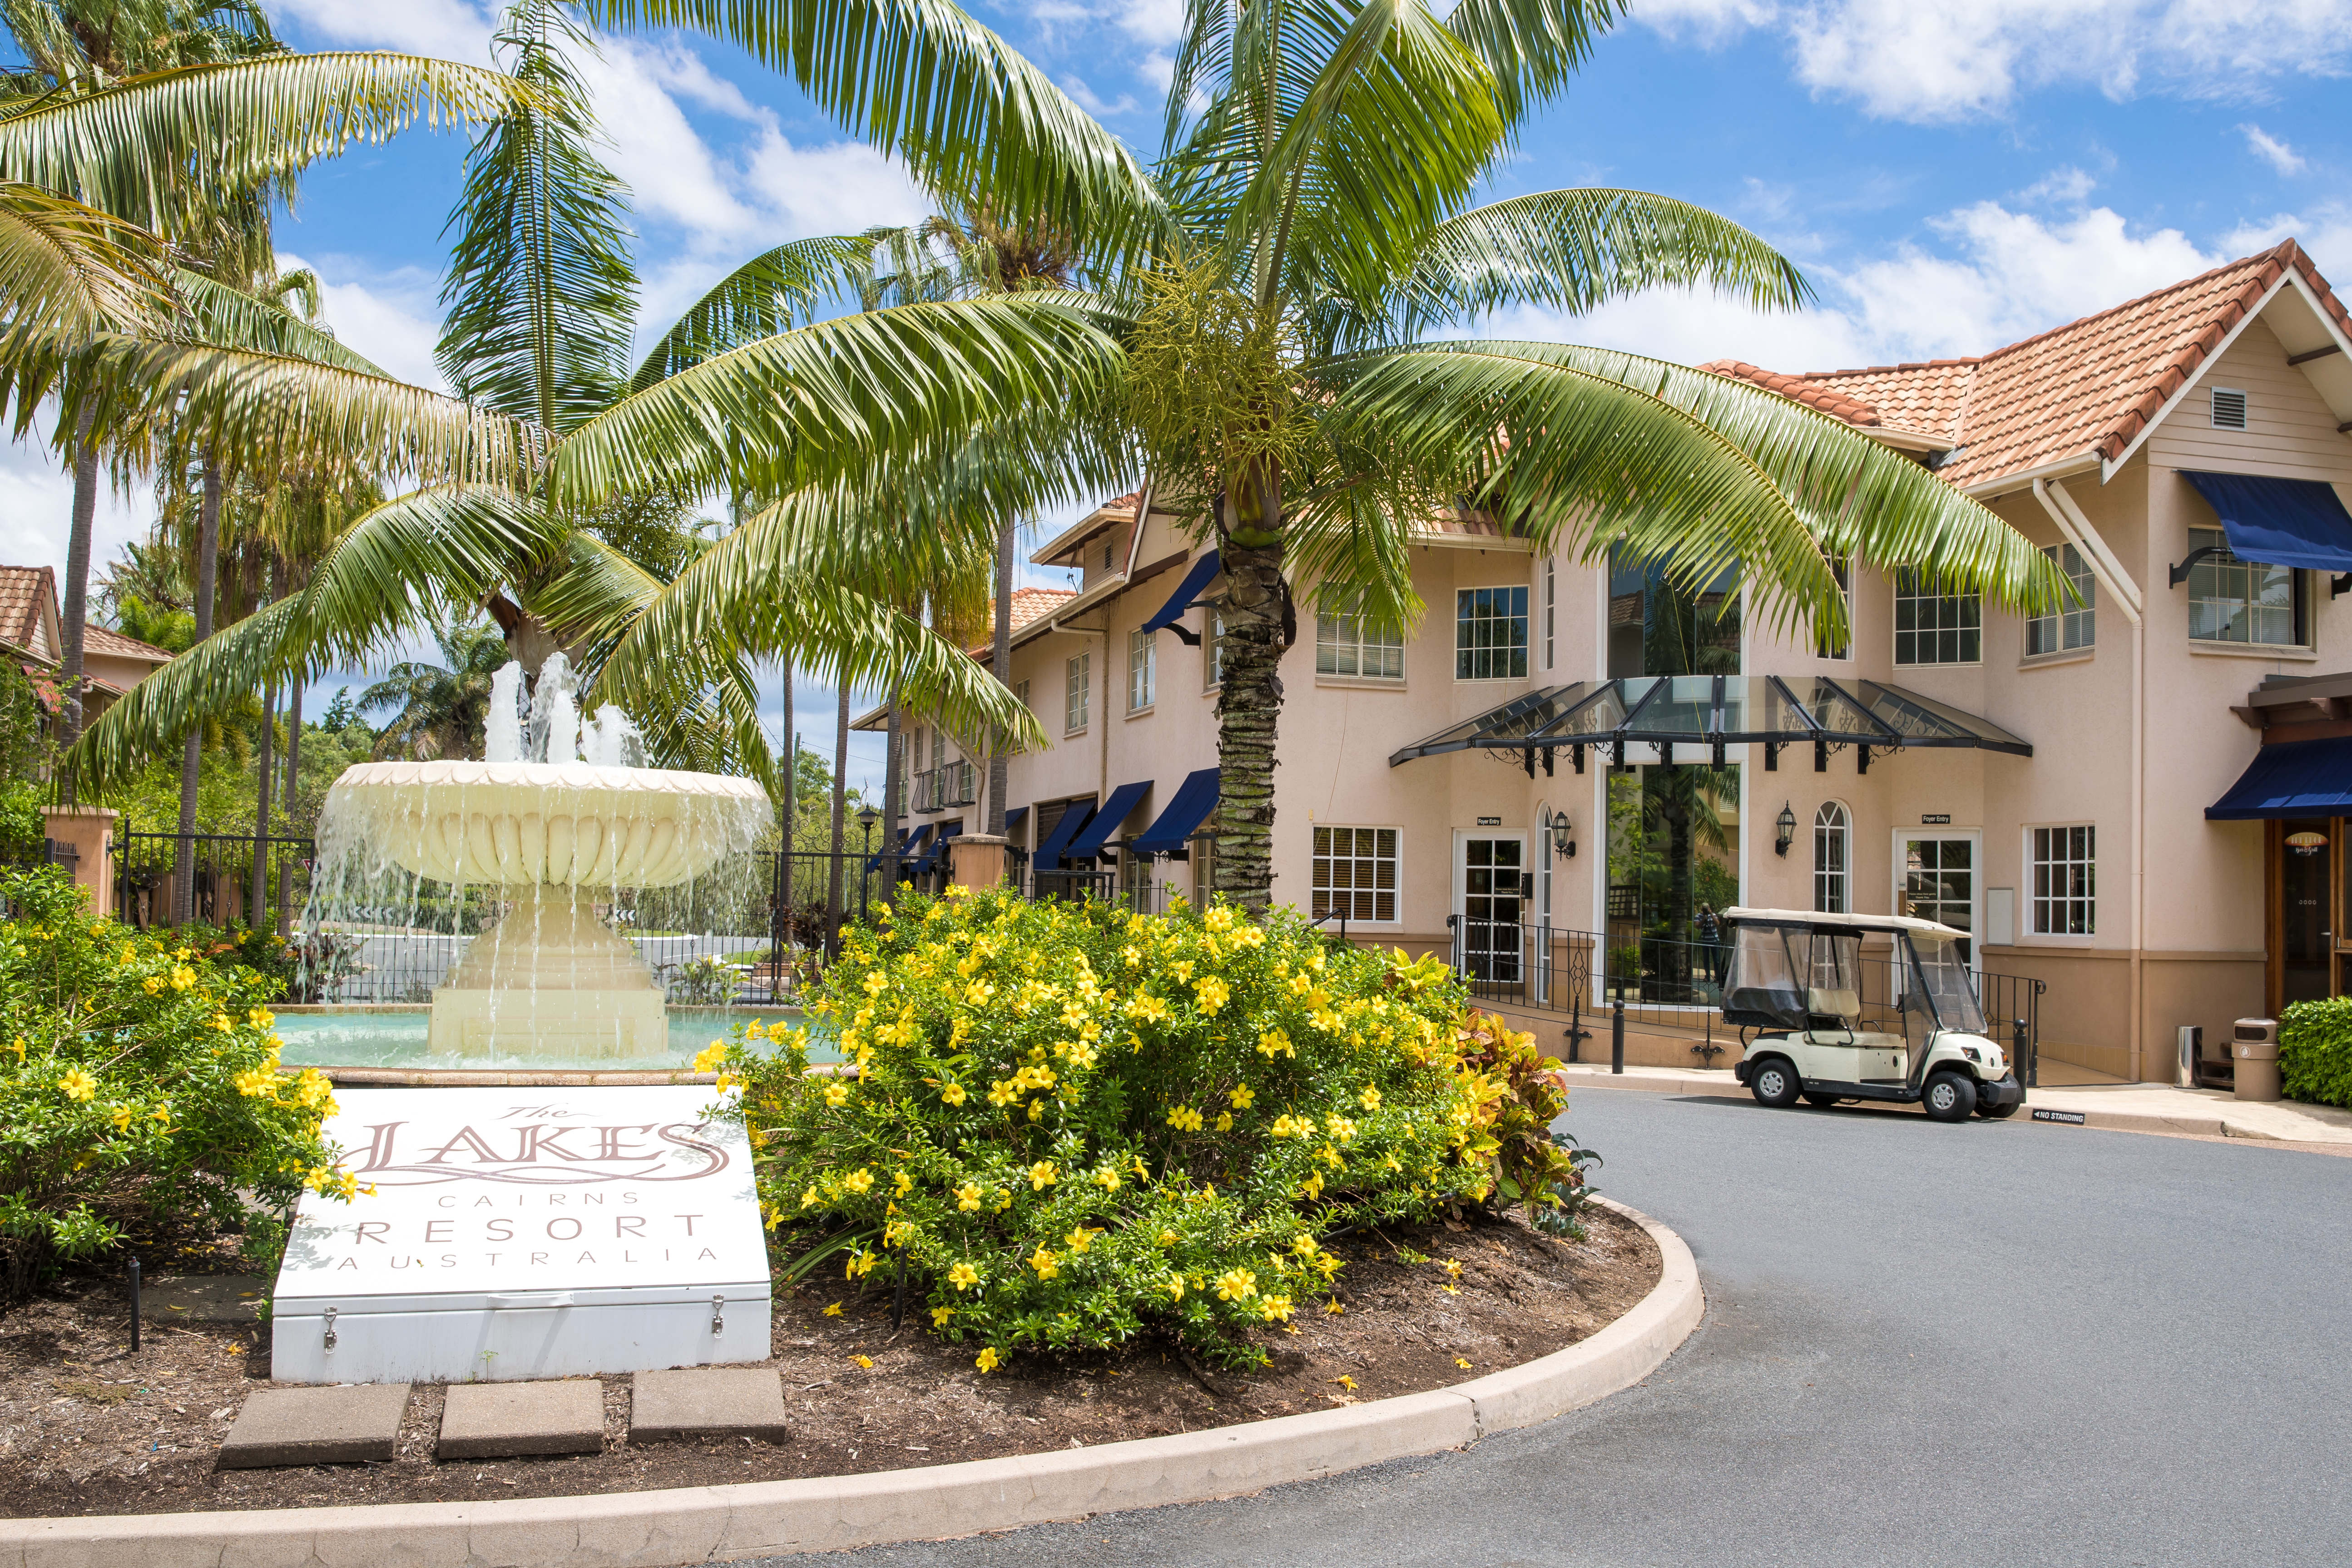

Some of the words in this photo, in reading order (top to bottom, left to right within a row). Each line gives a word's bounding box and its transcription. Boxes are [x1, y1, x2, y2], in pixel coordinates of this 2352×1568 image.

[489, 1103, 604, 1120] The
[2051, 1113, 2084, 1122] STANDING
[334, 1122, 730, 1185] LAKES
[438, 1192, 638, 1208] CAIRNS
[356, 1215, 703, 1245] RESORT
[337, 1247, 717, 1270] AUSTRALIA
